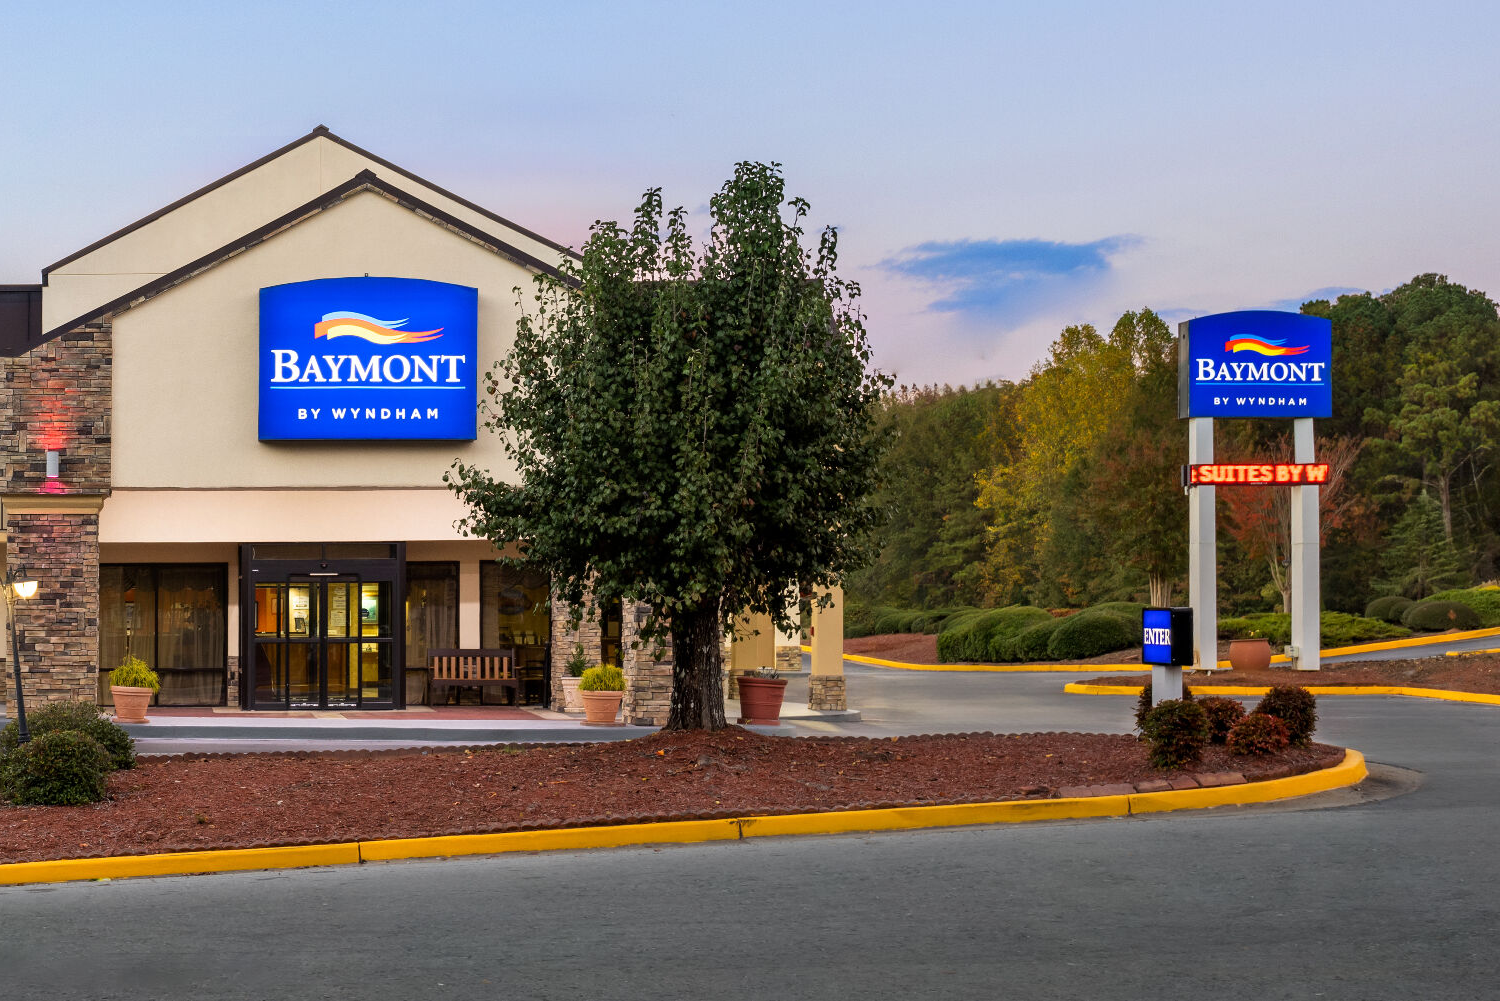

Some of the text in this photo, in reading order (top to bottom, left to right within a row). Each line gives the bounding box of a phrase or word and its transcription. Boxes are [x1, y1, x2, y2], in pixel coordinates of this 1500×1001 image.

[270, 349, 466, 383] BAYMONT
[1195, 358, 1325, 382] BAYMONT
[1213, 397, 1307, 406] BY WYNDHAM
[297, 407, 439, 420] BY WYNDHAM
[1199, 465, 1274, 482] SUITES
[1275, 465, 1303, 482] BY
[1143, 627, 1171, 646] ENTER
